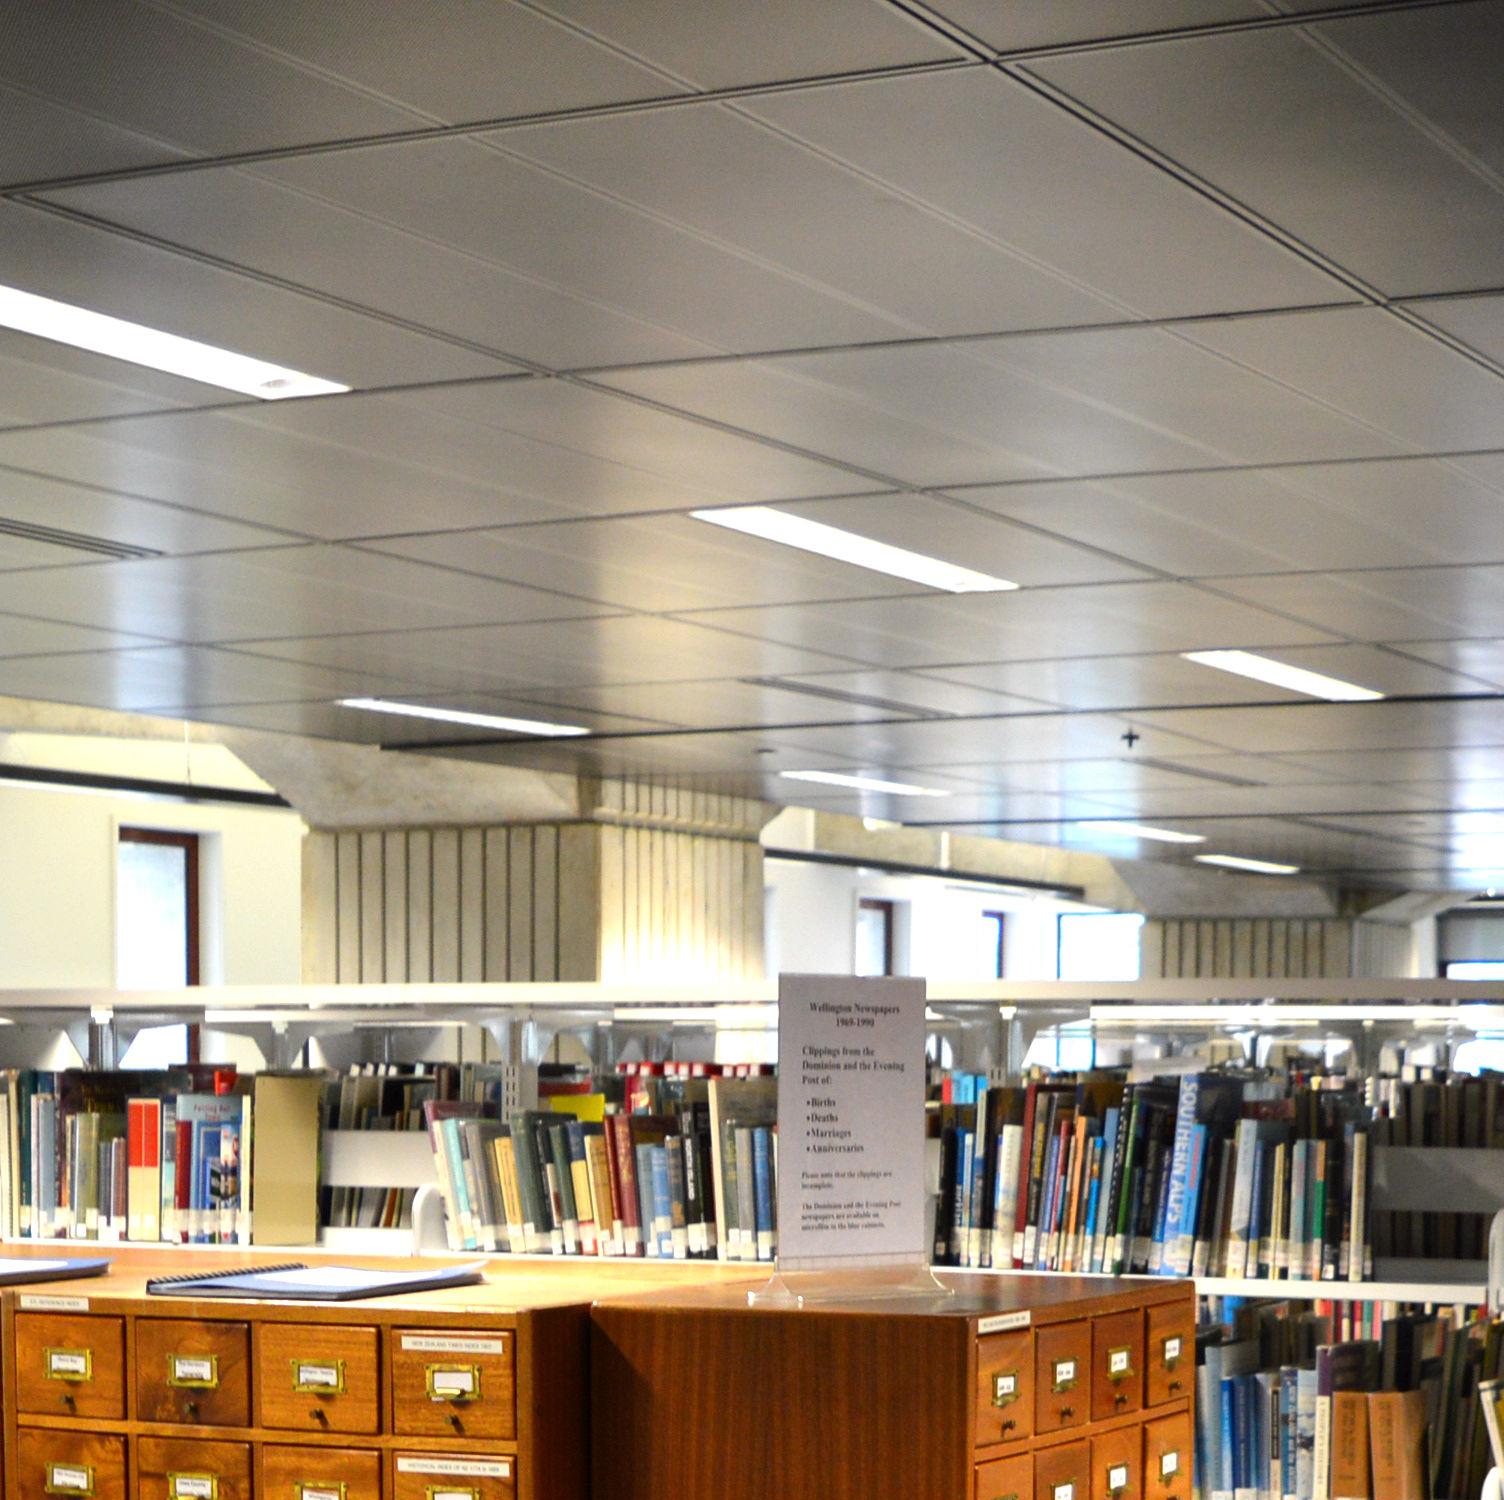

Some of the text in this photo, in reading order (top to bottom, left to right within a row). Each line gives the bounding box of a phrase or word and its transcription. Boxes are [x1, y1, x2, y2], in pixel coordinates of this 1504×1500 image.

[809, 1002, 900, 1016] Wellington Newspapers
[802, 1045, 875, 1058] Clippings from the
[802, 1060, 905, 1073] Dominion and the Evening
[802, 1075, 819, 1085] Post
[1173, 1081, 1198, 1174] SOUTHERN
[1168, 1179, 1183, 1223] ALPS
